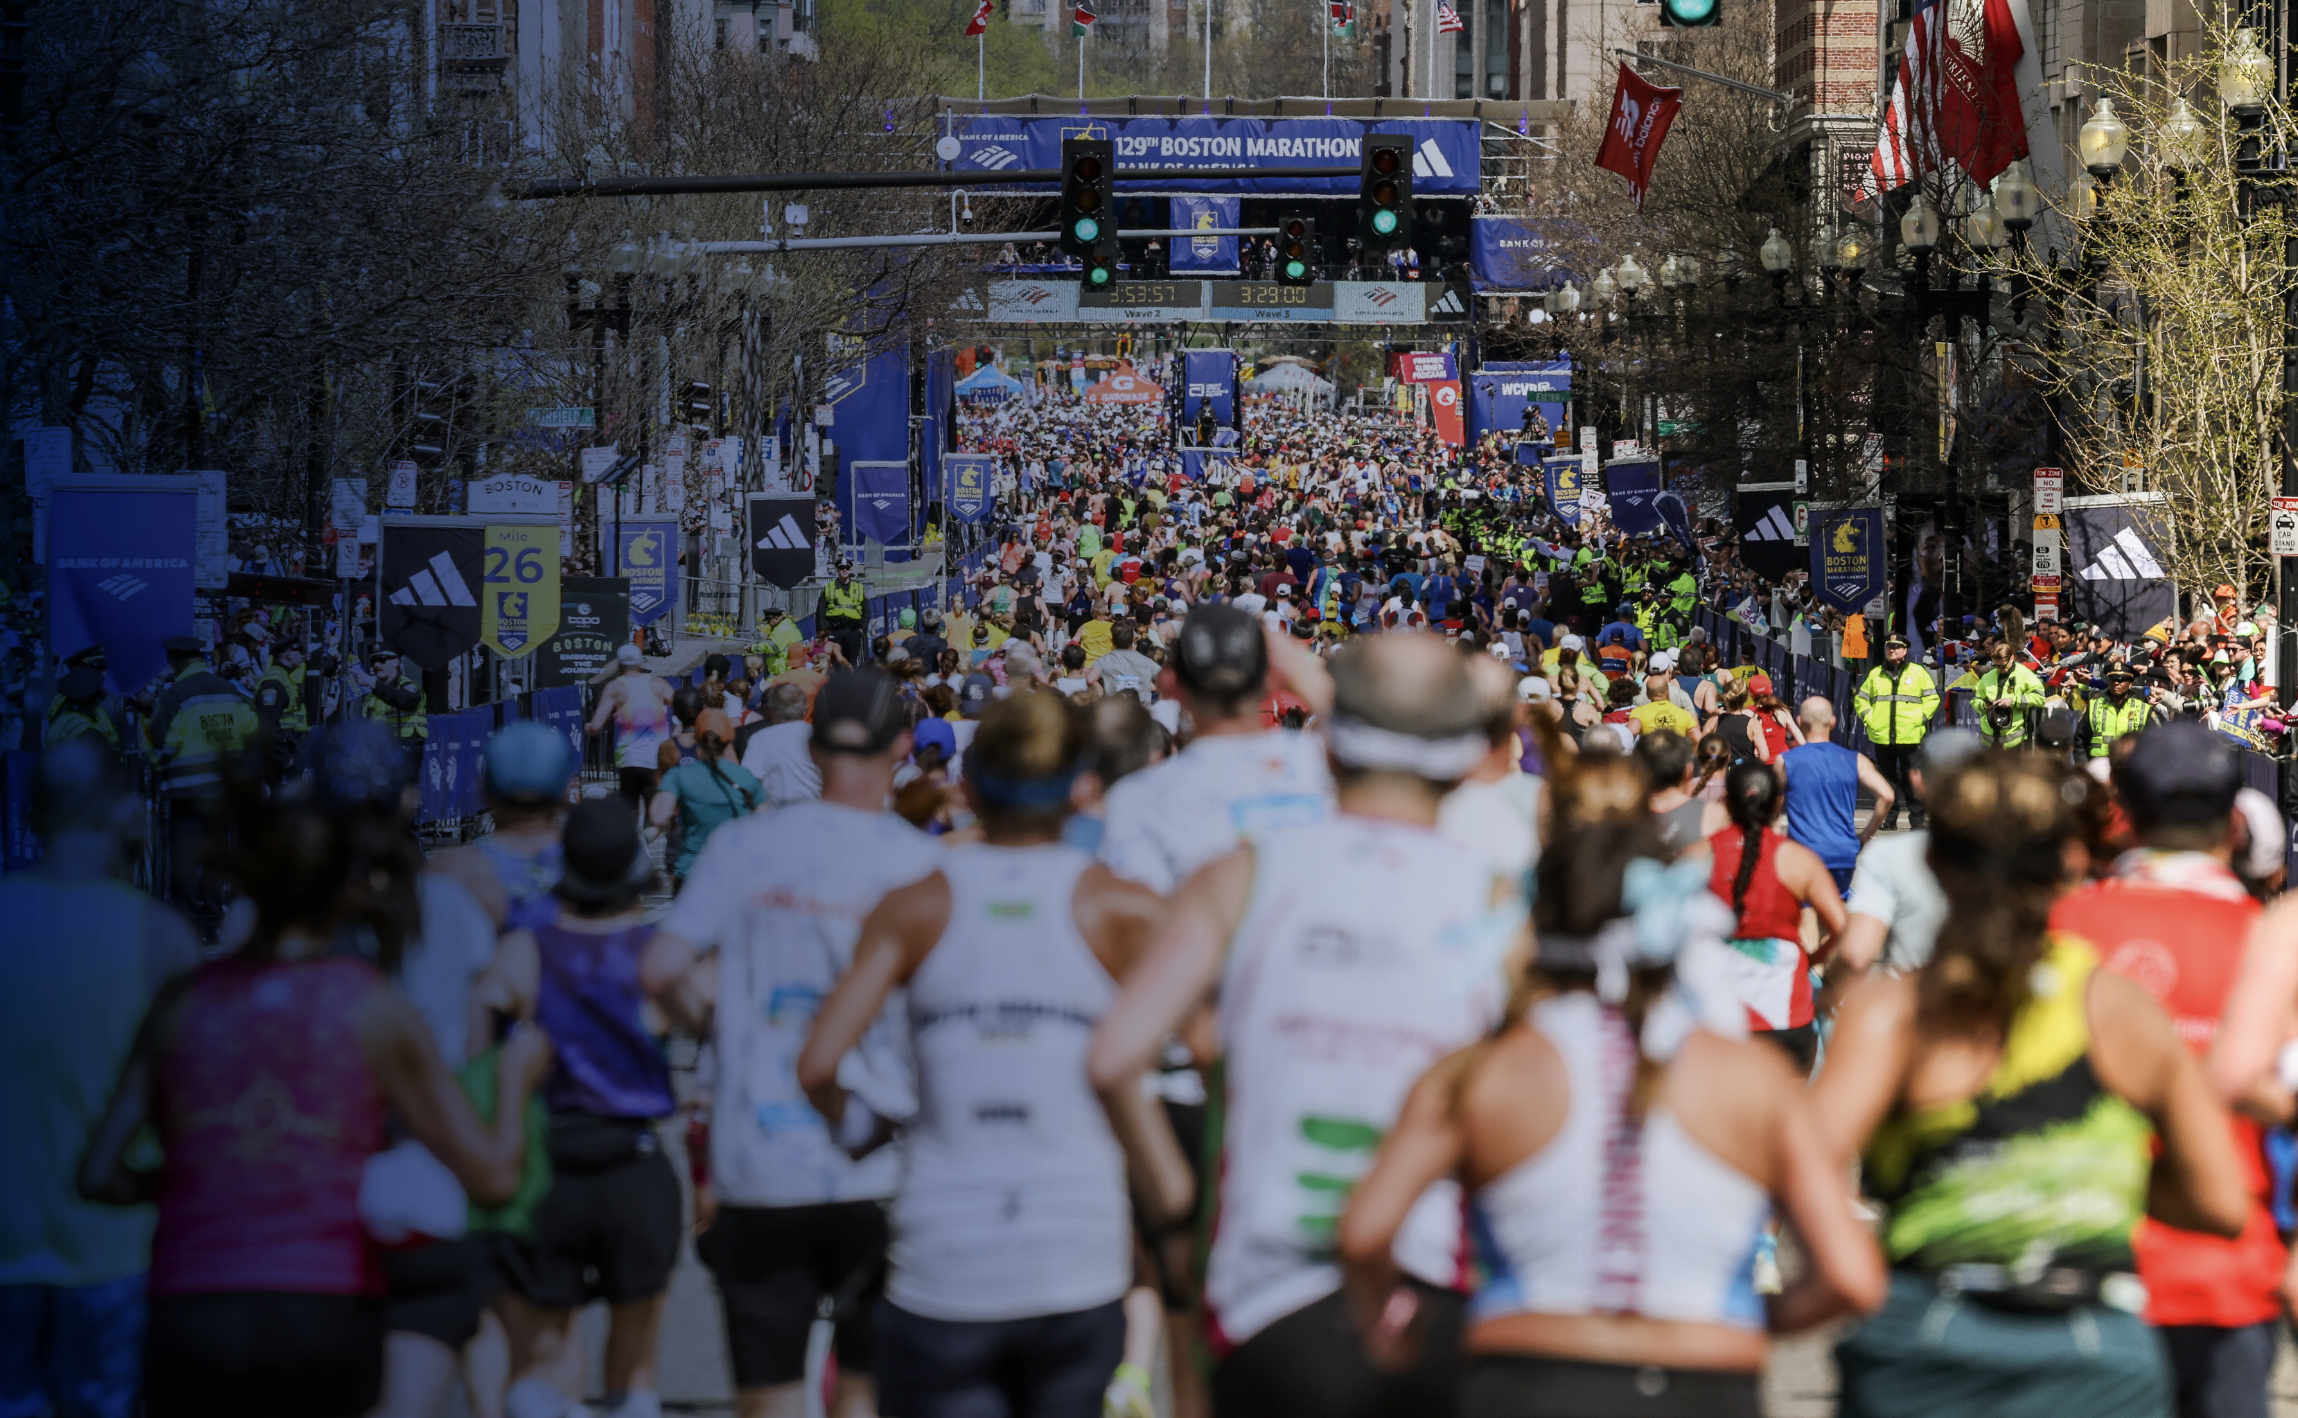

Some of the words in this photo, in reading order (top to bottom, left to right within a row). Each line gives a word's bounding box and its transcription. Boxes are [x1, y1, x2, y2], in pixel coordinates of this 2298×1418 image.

[1634, 96, 1663, 148] balance
[1115, 136, 1159, 156] 129TH
[1161, 136, 1241, 157] BOSTON
[1246, 137, 1360, 158] MARATHON
[1500, 239, 1528, 248] BANK
[1241, 286, 1306, 304] 3:29:00
[1125, 310, 1153, 318] Wave
[1154, 310, 1161, 318] 2
[1255, 309, 1282, 318] Wave
[1284, 309, 1290, 318] 3
[1111, 375, 1135, 391] G
[1501, 382, 1538, 396] WCVB
[1101, 392, 1150, 402] GATORADE
[485, 481, 543, 495] BOSTON
[1555, 488, 1581, 496] BOSTON
[522, 501, 539, 509] 1630
[2273, 500, 2284, 508] TOW
[499, 531, 528, 542] Mile
[56, 558, 99, 569] BANK
[100, 558, 121, 569] OF
[121, 557, 188, 569] AMERICA
[483, 546, 544, 584] 26
[1826, 555, 1866, 566] BOSTON
[621, 567, 662, 577] BOSTON
[1827, 565, 1866, 573] MARATHON
[553, 637, 612, 653] BOSTON
